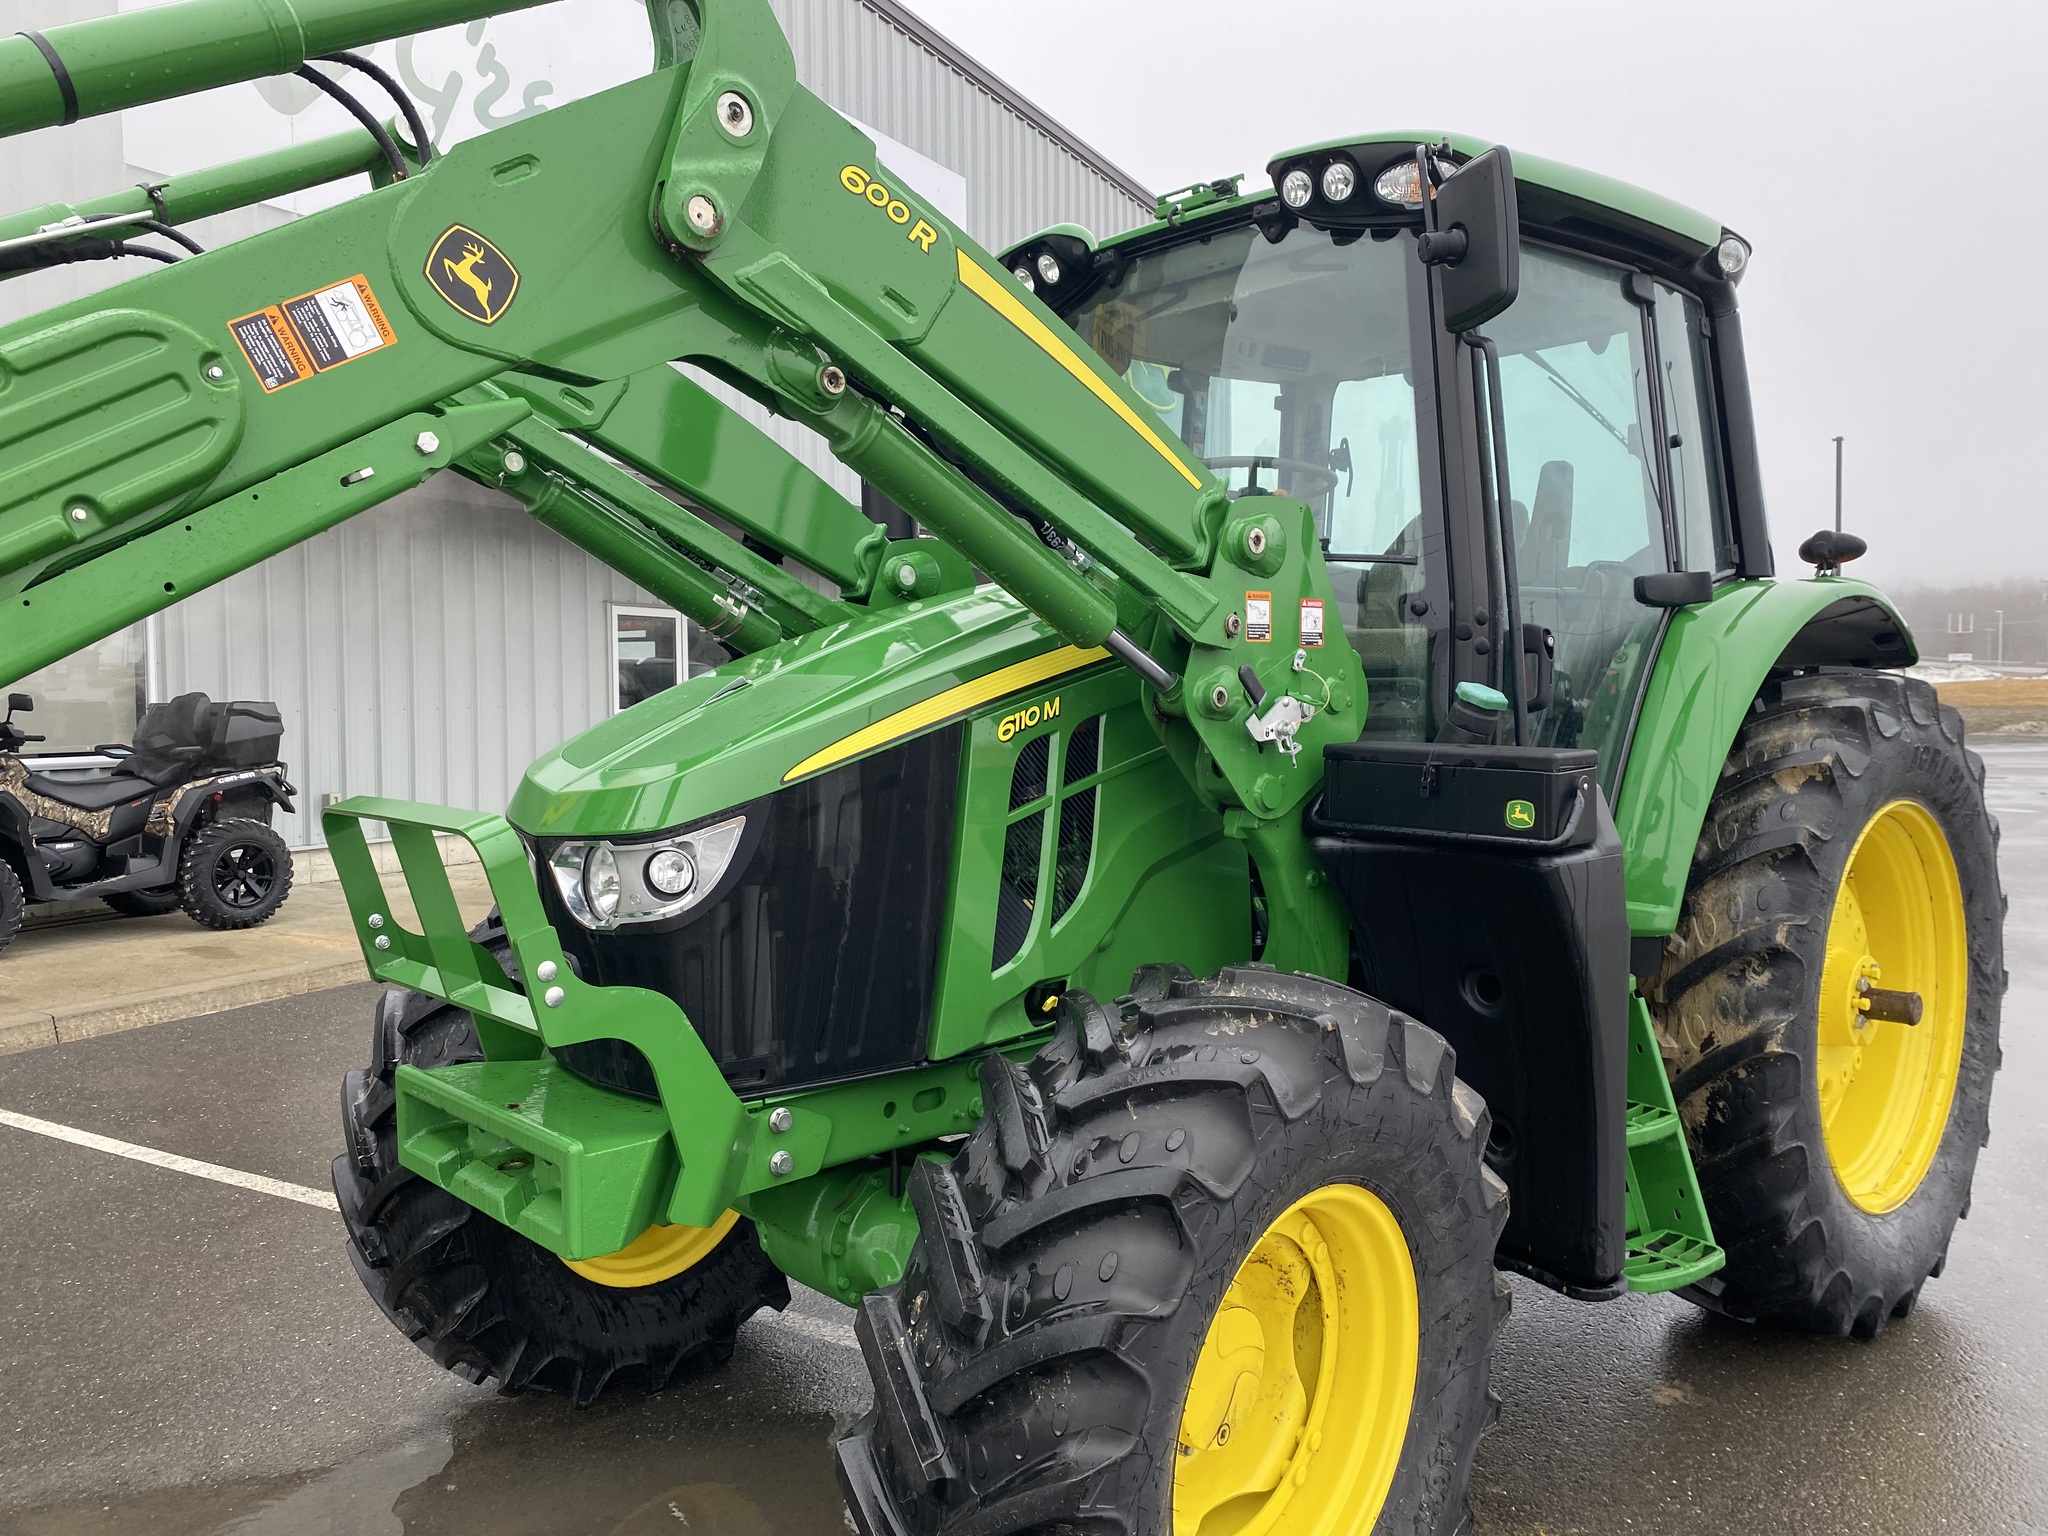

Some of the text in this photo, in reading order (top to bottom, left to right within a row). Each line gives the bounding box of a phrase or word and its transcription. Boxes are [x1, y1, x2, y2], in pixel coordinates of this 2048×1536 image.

[363, 293, 390, 337] WARNING
[276, 326, 306, 371] WARNING
[217, 771, 256, 784] can-am
